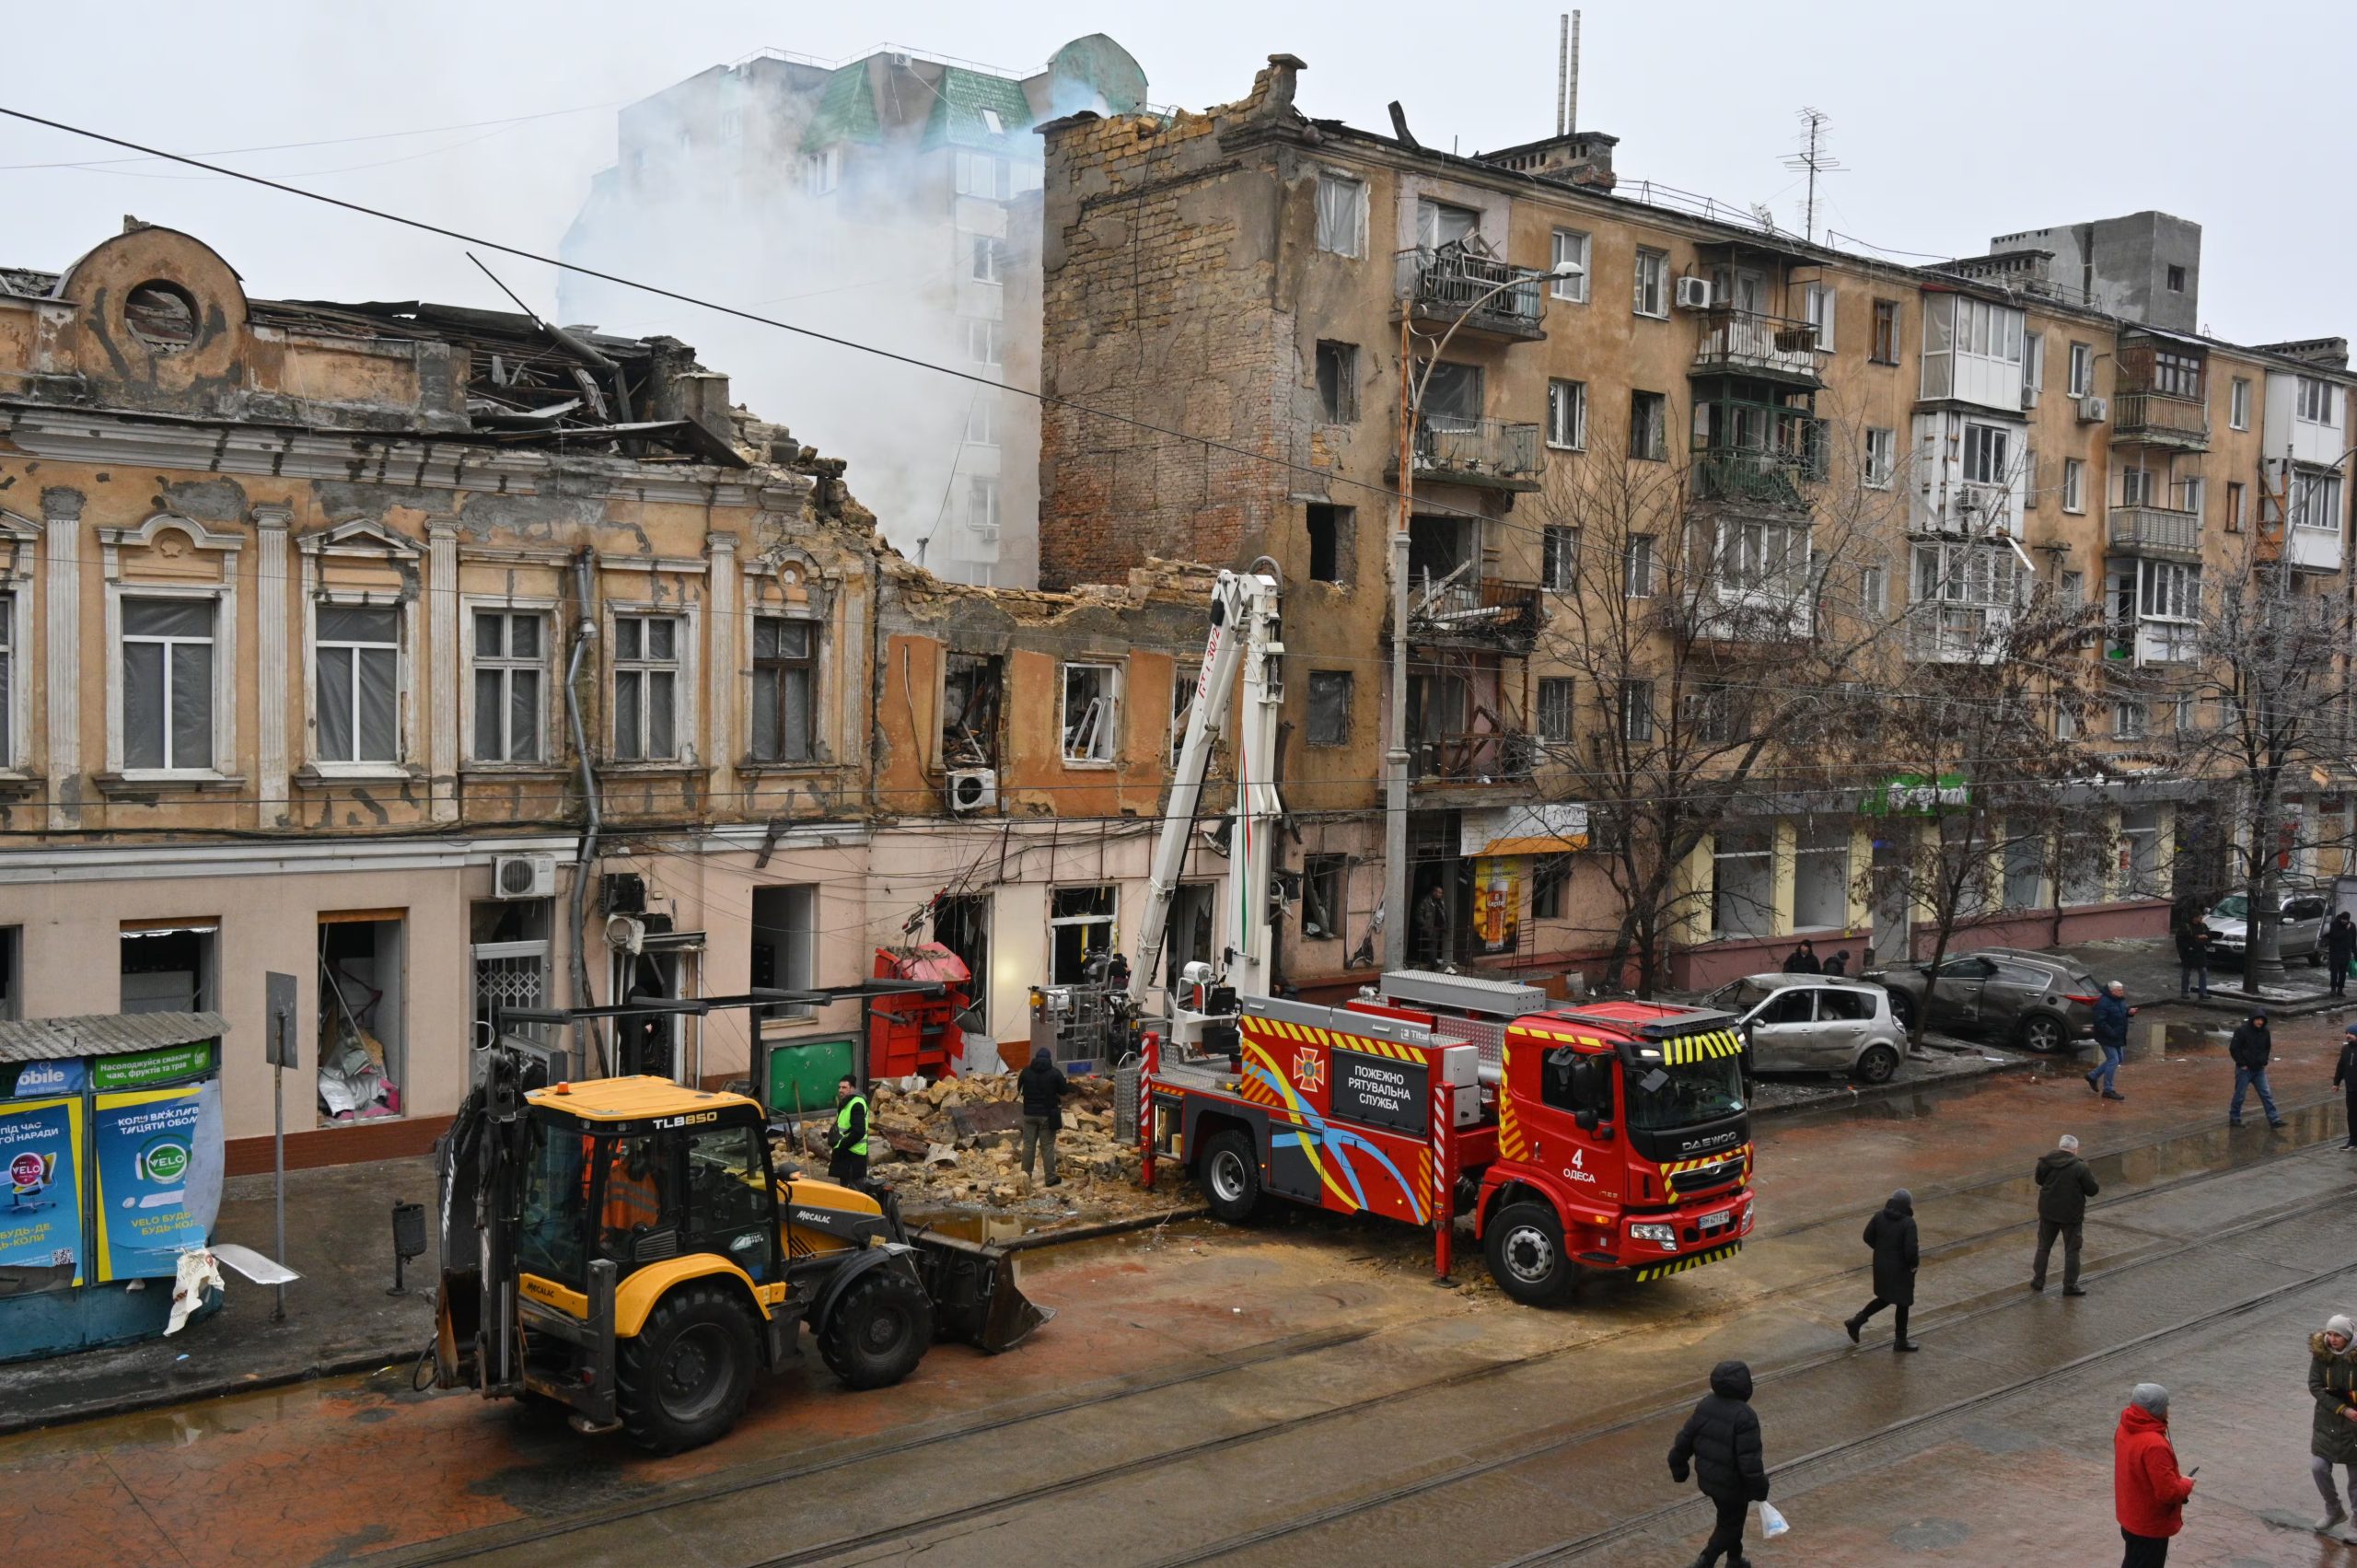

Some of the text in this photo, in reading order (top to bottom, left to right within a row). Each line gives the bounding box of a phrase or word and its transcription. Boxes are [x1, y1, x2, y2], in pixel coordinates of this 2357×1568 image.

[100, 1056, 162, 1072] Насолоджуйся
[162, 1052, 192, 1064] смаками
[17, 1068, 64, 1086] obile
[106, 1062, 188, 1081] чаю, фруктів та трав
[1355, 1065, 1404, 1085] ПОЖЕЖНО
[1348, 1077, 1411, 1100] РЯТУВАЛЬНА
[1359, 1093, 1399, 1111] СЛУЖБА
[21, 1121, 41, 1132] ЧАС
[121, 1121, 165, 1135] ТИЦЯТИ
[653, 1111, 717, 1130] TLB850
[17, 1127, 59, 1143] НАРАДИ
[1682, 1131, 1737, 1151] DAEWOO
[150, 1154, 184, 1168] VELO
[1572, 1148, 1583, 1170] 4
[12, 1164, 41, 1176] VELO
[1562, 1167, 1596, 1184] ОДЕСА
[132, 1215, 160, 1228] VELO
